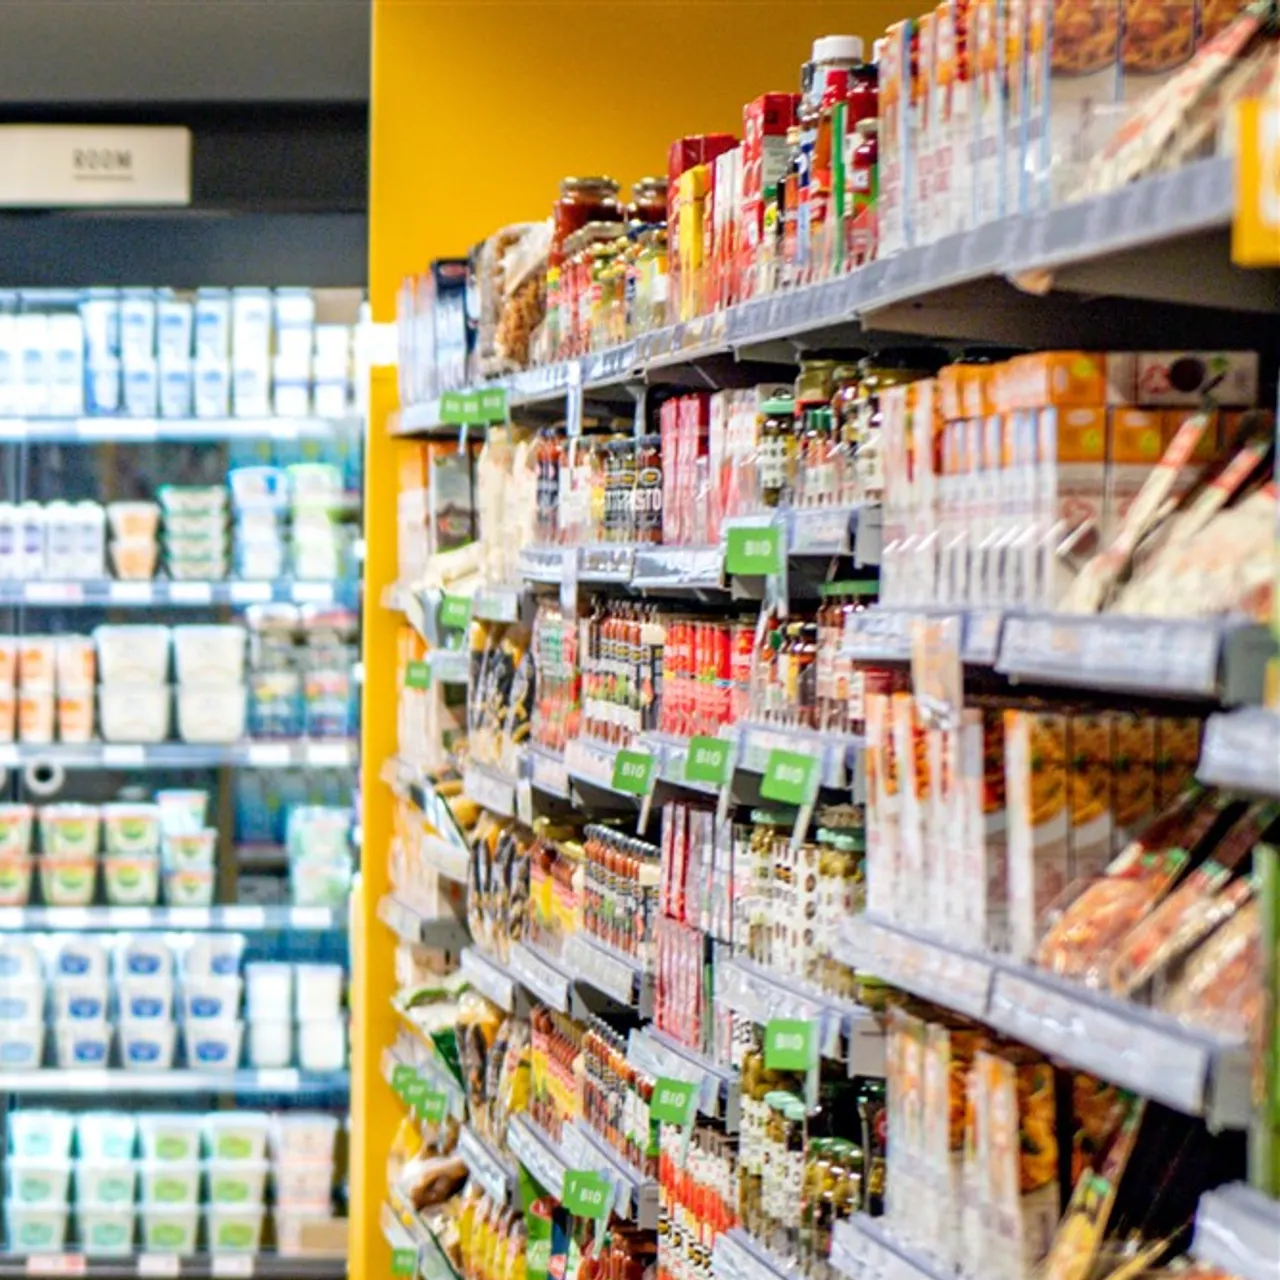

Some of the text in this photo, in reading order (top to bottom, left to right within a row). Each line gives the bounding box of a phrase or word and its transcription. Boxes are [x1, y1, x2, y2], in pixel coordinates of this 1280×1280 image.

[72, 149, 133, 169] ROOM
[744, 540, 772, 556] BIO
[694, 750, 721, 767] BIO
[622, 761, 645, 779] BIO
[773, 763, 805, 784] BIO
[773, 1032, 805, 1050] BIO
[659, 1089, 686, 1108] BIO
[578, 1185, 602, 1204] BIO
